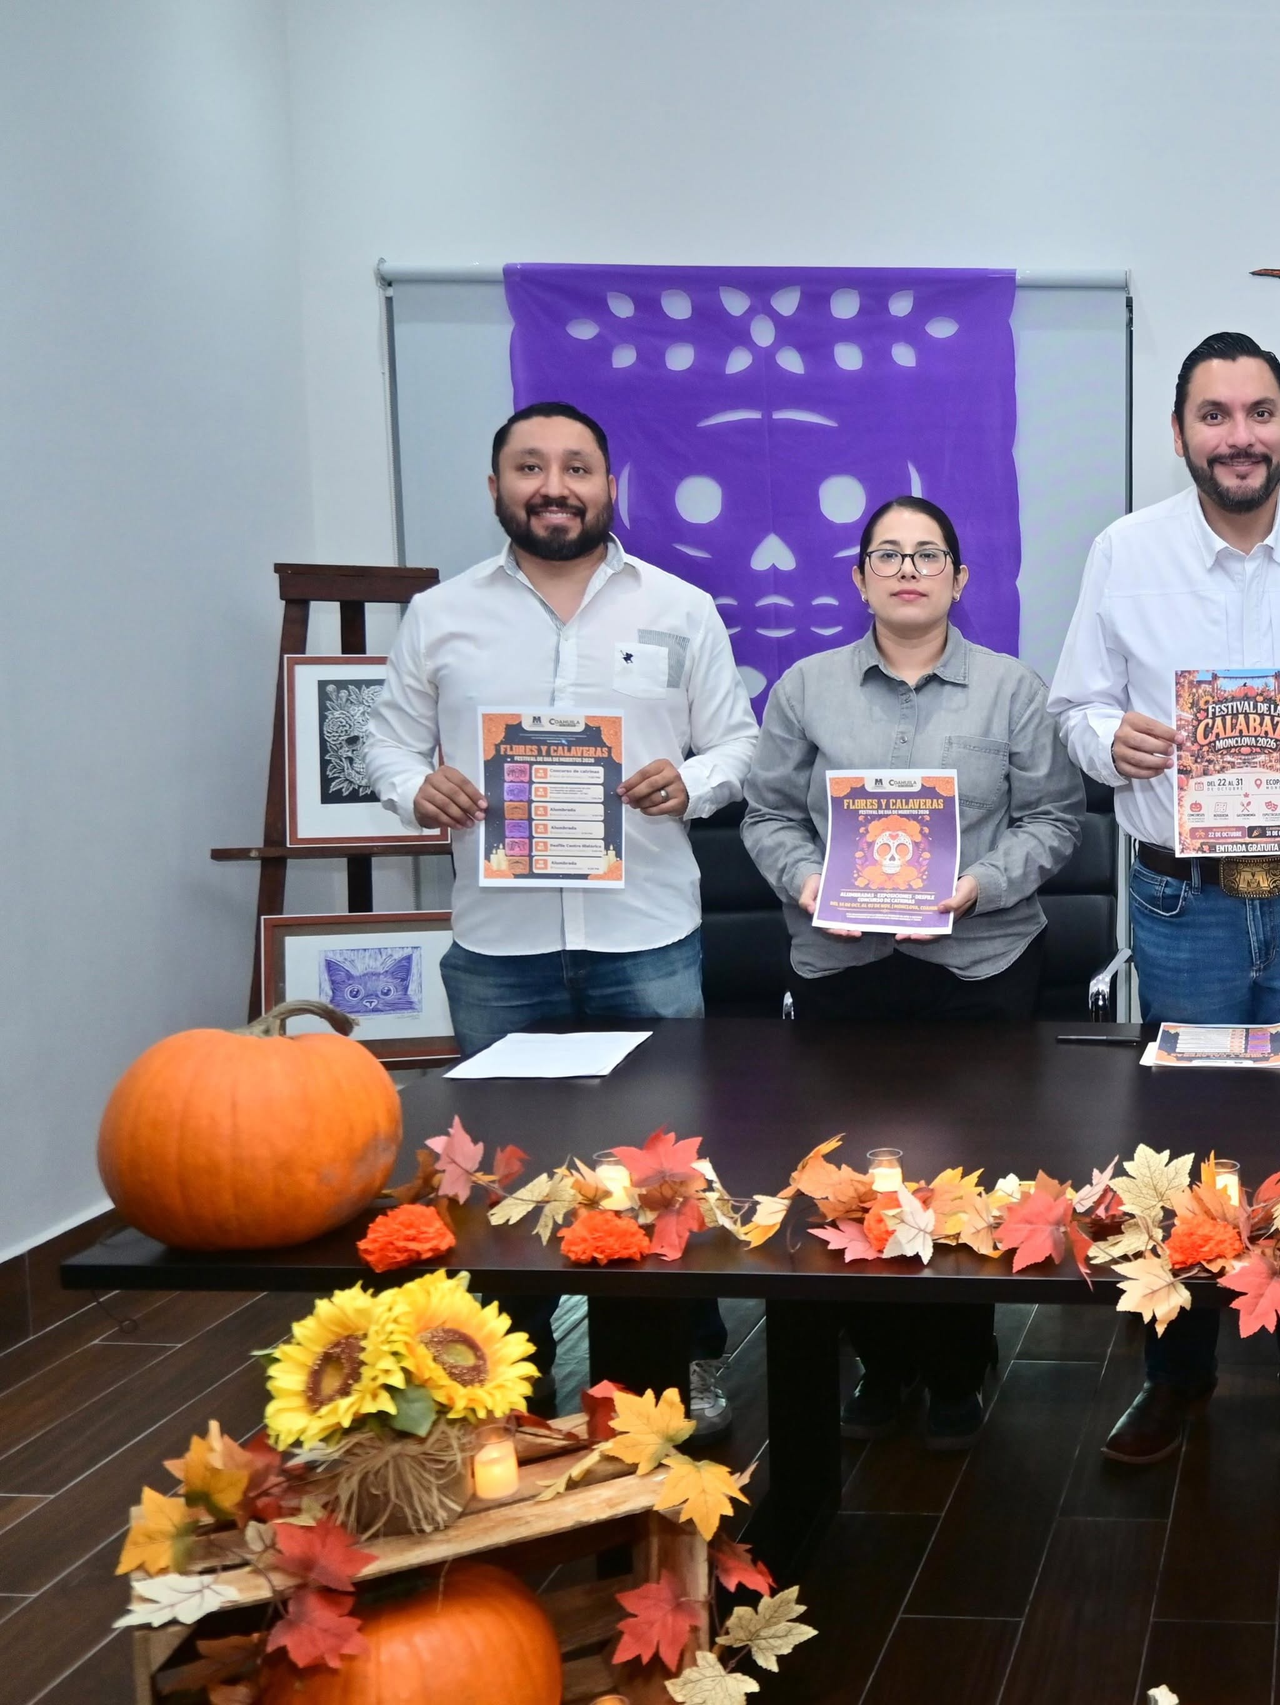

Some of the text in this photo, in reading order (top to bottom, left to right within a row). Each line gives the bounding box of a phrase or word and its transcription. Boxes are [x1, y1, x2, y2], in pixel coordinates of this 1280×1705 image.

[1208, 701, 1256, 718] FESTIVAL
[1257, 703, 1270, 714] DE
[1216, 737, 1276, 750] MONCLOVA 2026
[501, 745, 608, 758] FLORES Y CALAVERAS
[1236, 778, 1243, 786] 31
[844, 799, 944, 809] FLORES Y CALAVERAS
[1216, 844, 1279, 852] ENTRADA GRATUITA
